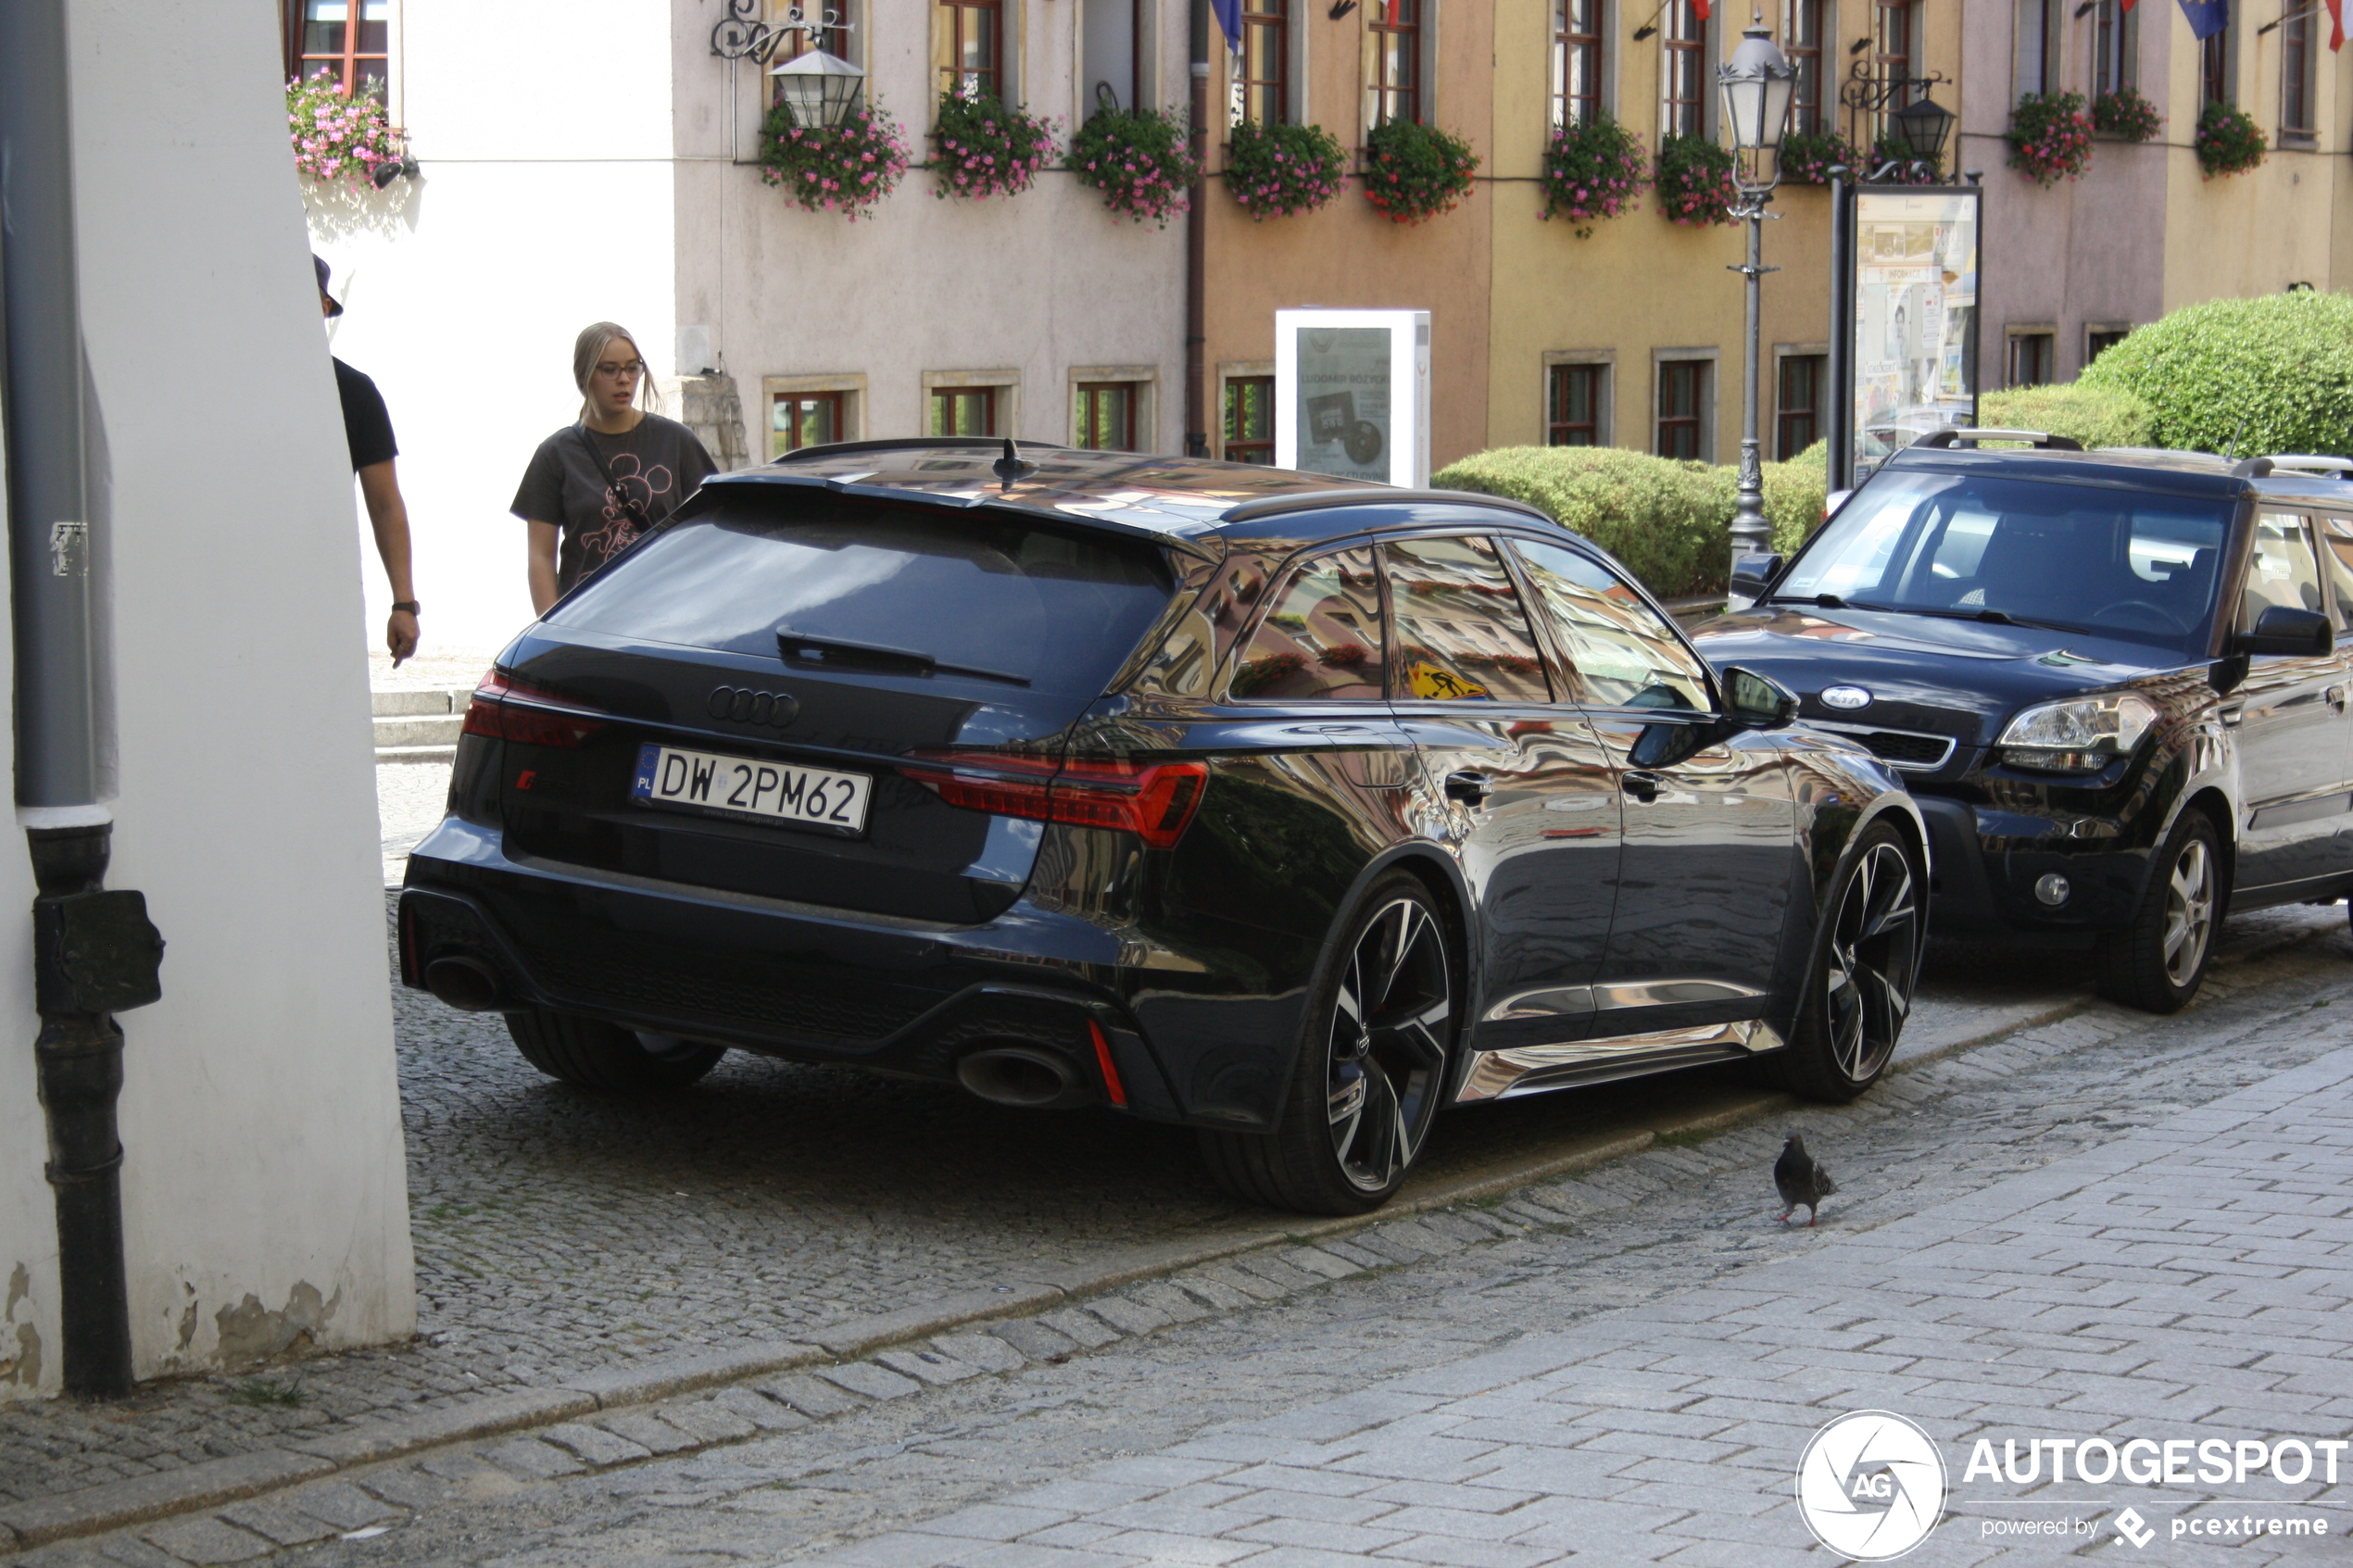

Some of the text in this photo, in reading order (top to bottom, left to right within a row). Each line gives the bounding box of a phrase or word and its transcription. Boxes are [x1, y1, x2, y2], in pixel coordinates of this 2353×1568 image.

[1301, 374, 1347, 384] LUDOMIR
[637, 777, 651, 790] PL
[661, 753, 856, 822] DW 2PM62
